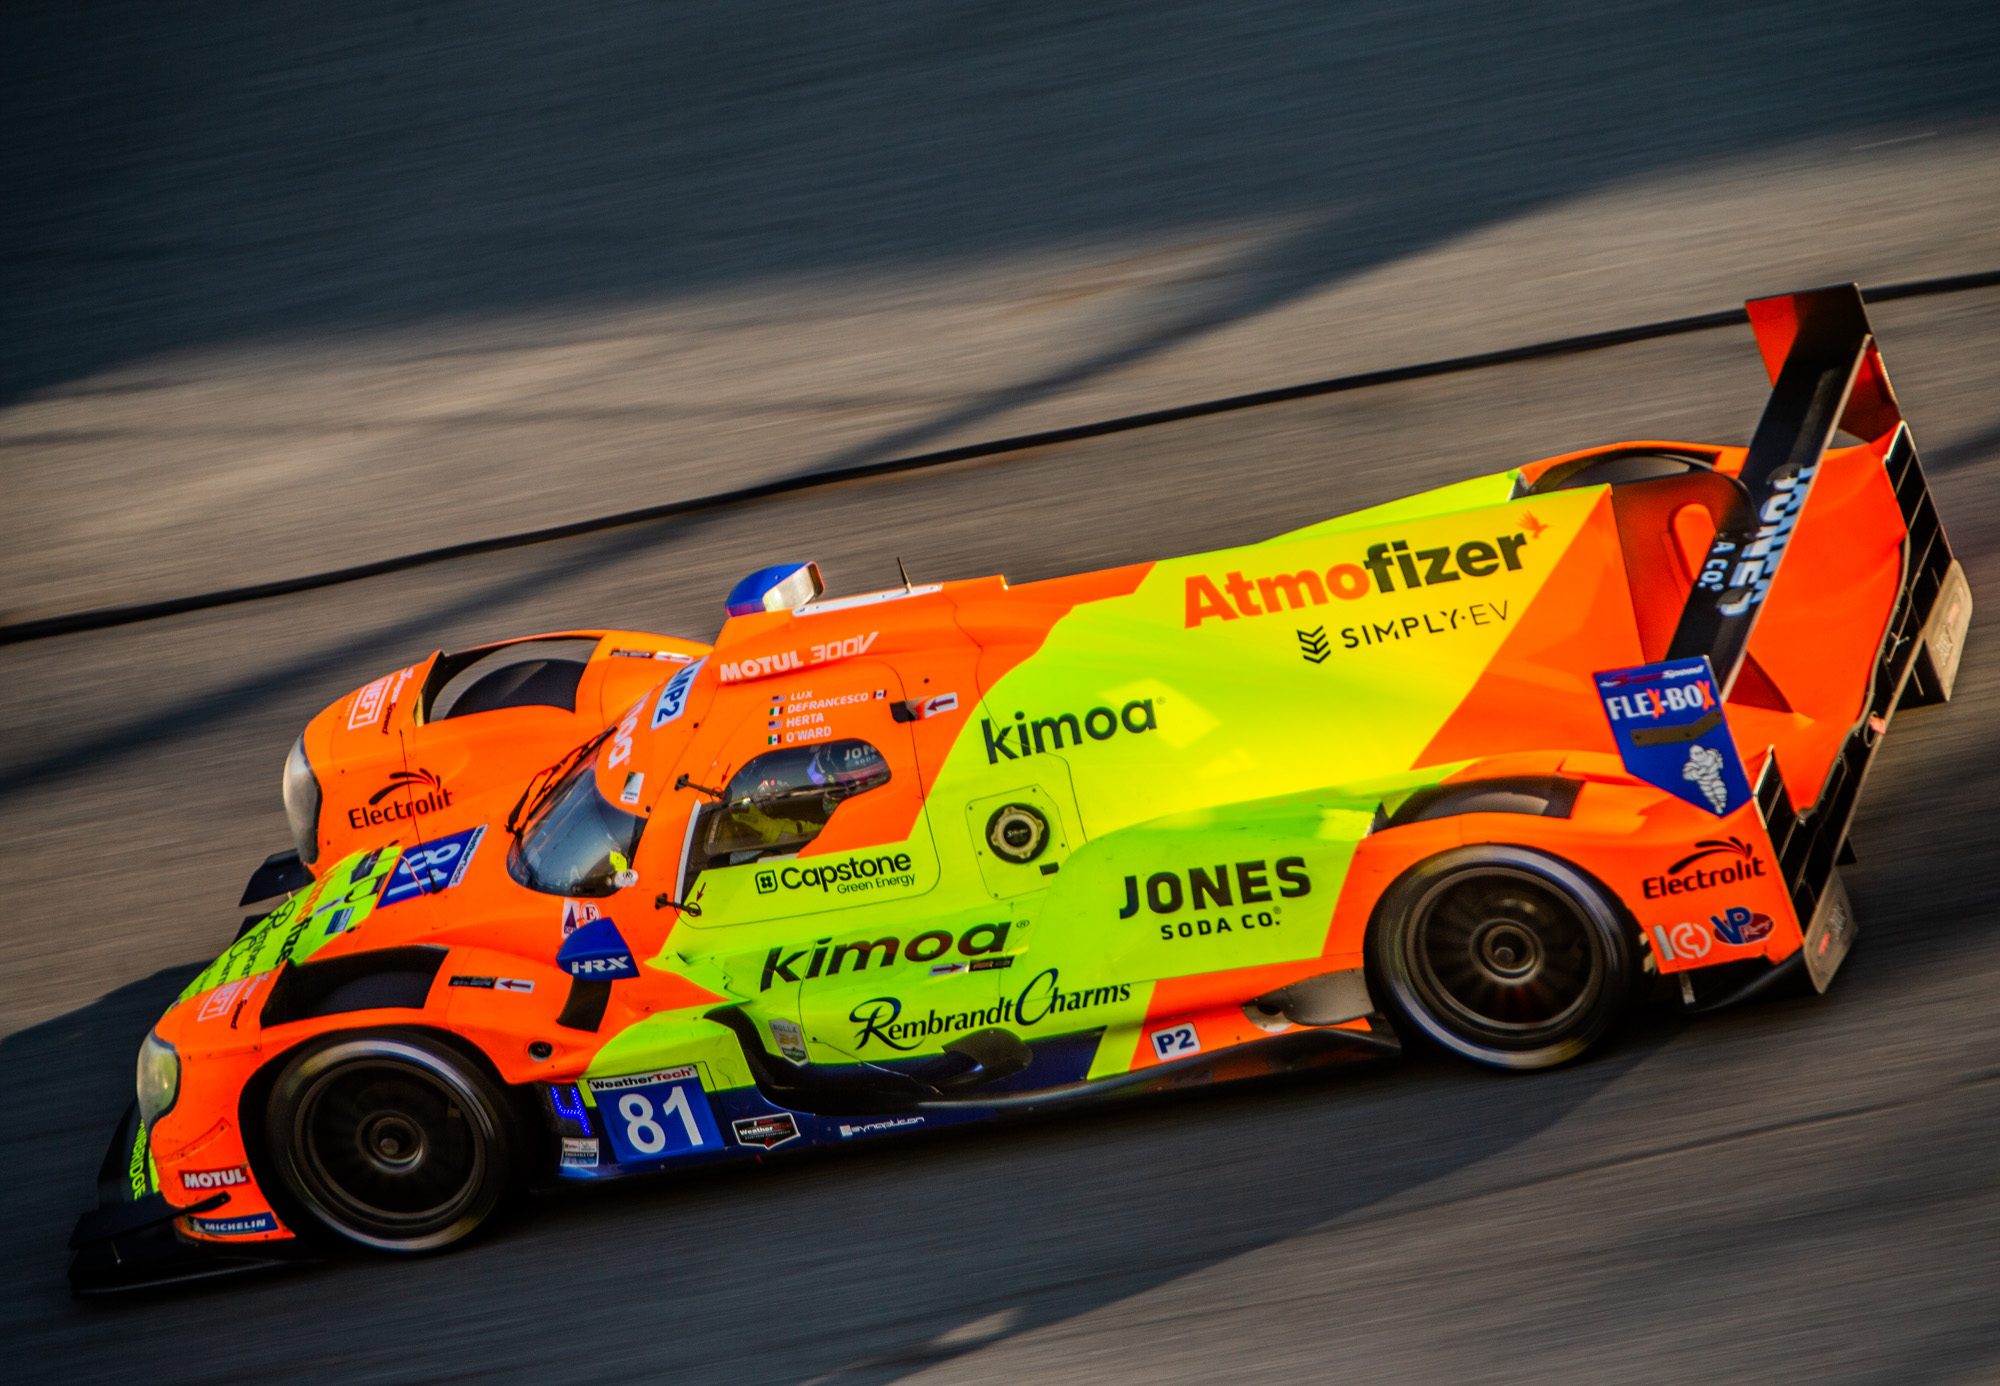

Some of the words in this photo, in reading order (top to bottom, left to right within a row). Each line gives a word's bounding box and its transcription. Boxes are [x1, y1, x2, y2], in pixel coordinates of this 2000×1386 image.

[1184, 533, 1527, 629] Atmofizer
[719, 650, 804, 682] MOTUL
[810, 631, 879, 664] 300V
[787, 692, 870, 714] DEFRANCESCO
[790, 690, 813, 700] LUX
[1606, 681, 1716, 720] FLEX-BOX
[785, 712, 825, 728] HERTA
[785, 725, 833, 743] O'WARD
[980, 698, 1157, 764] kimoa
[348, 790, 453, 830] Electrolit
[387, 843, 461, 897] 81
[781, 852, 913, 893] Capstone
[837, 881, 874, 894] Green
[875, 873, 916, 889] Energy
[1119, 855, 1311, 919] JONES
[1642, 857, 1767, 899] Electrolit
[1161, 915, 1233, 940] SODA
[1242, 911, 1281, 930] CO.
[761, 921, 1012, 993] kimoa
[849, 996, 1015, 1051] Rembrandt
[1014, 968, 1131, 1026] Charms
[1156, 1029, 1195, 1055] P2
[592, 1068, 691, 1089] WeatherTech
[618, 1086, 704, 1154] 81
[184, 1168, 246, 1188] MOTUL
[205, 1219, 266, 1231] MICHELIN
